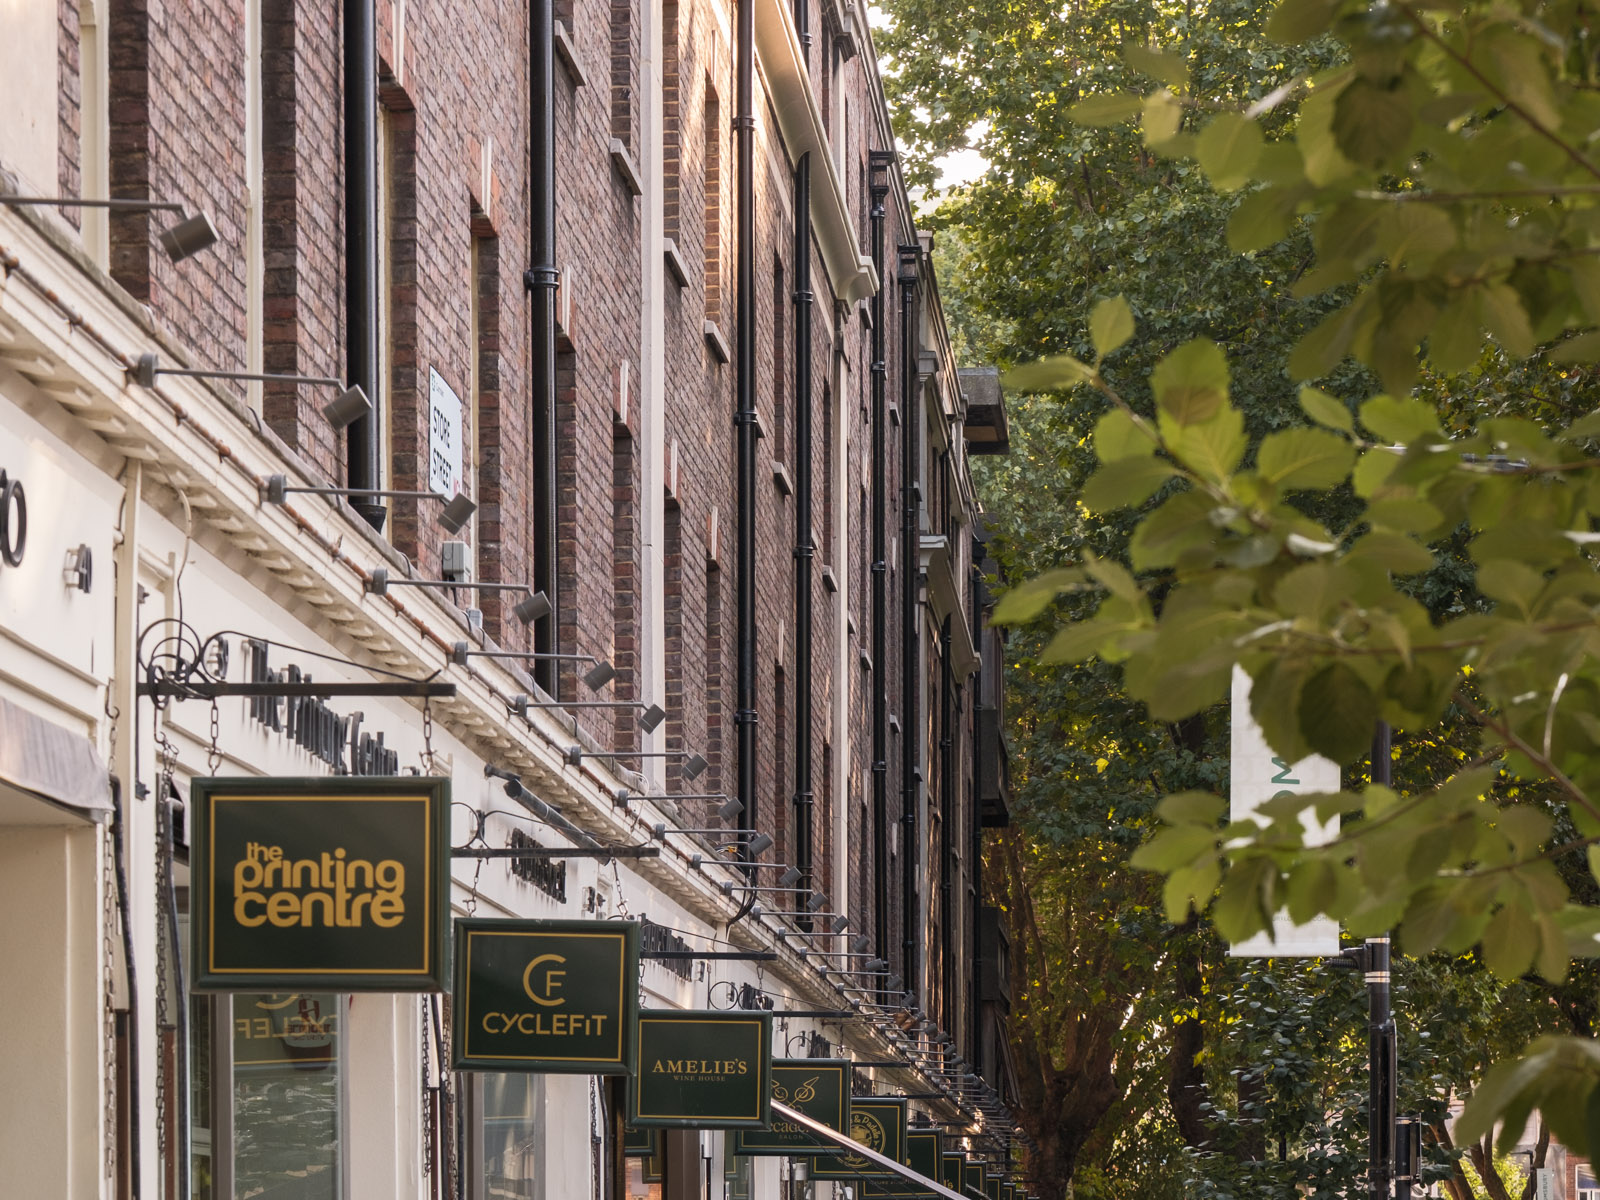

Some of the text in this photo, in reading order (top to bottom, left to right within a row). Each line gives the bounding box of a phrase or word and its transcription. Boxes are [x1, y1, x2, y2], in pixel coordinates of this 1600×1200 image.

[433, 405, 451, 449] STORE
[432, 448, 452, 490] STREET
[246, 841, 284, 862] the
[233, 847, 405, 898] printing
[233, 890, 405, 928] centre
[651, 1058, 748, 1075] AMELIE'S
